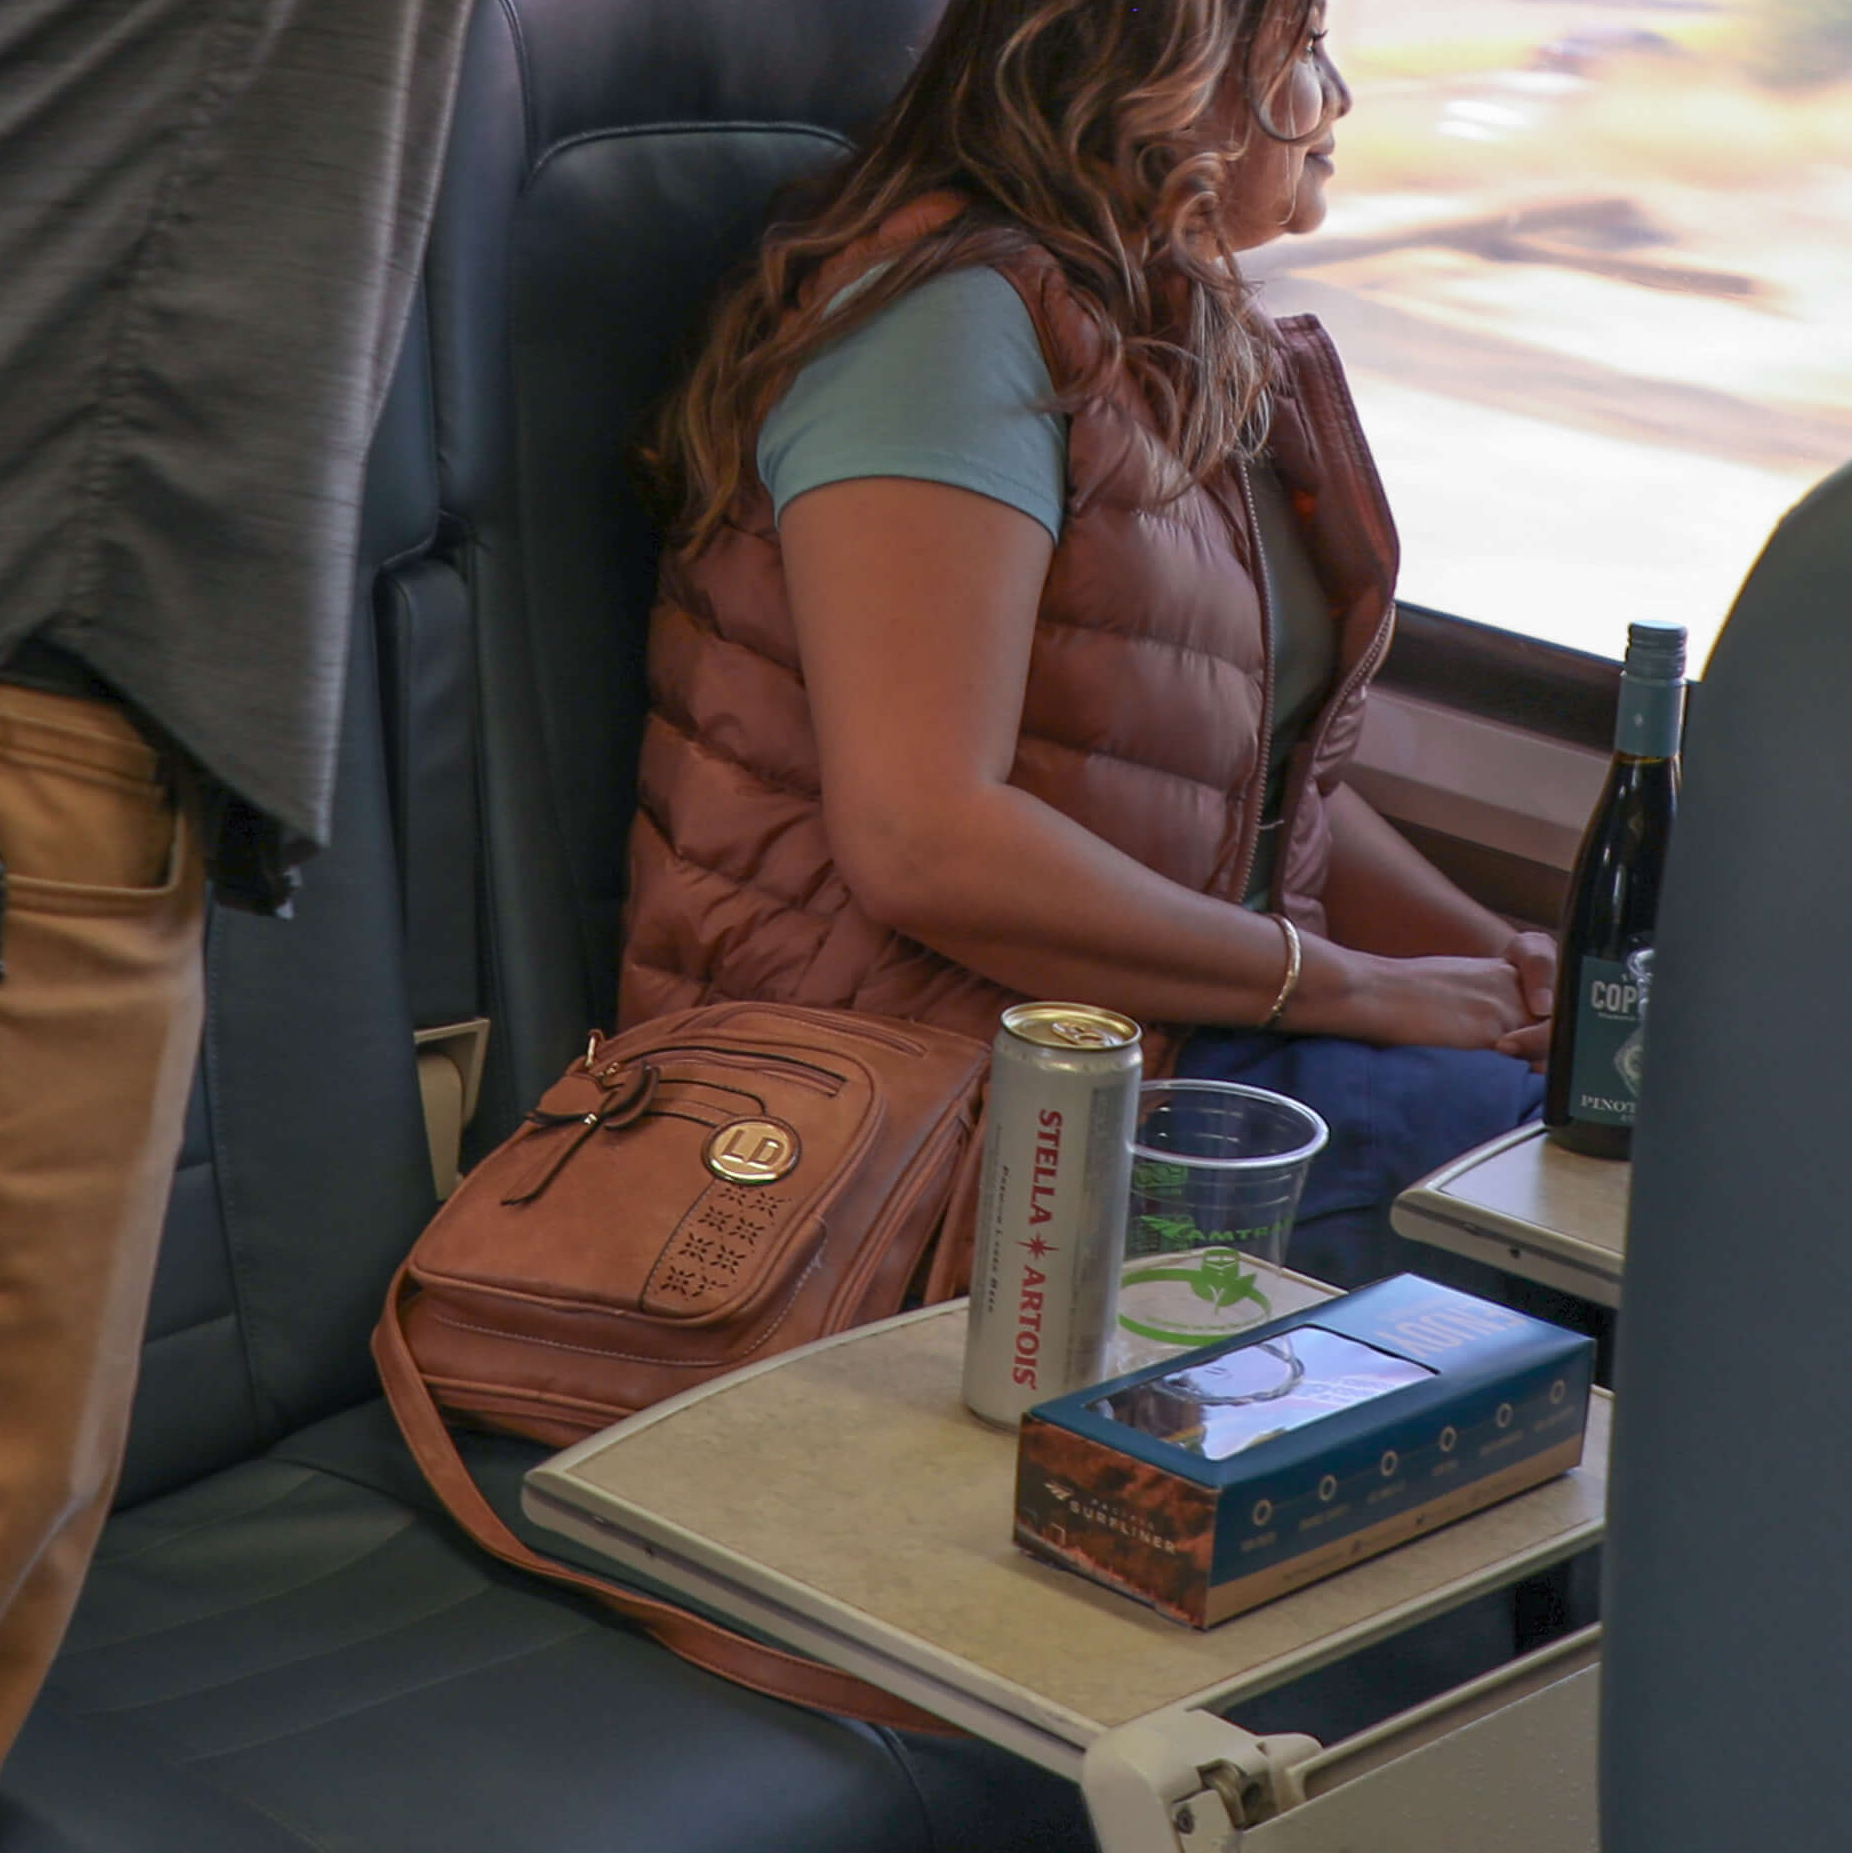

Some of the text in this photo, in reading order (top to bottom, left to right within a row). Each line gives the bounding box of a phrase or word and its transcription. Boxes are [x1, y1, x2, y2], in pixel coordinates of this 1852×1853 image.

[1581, 1094, 1636, 1114] PINOT
[721, 1129, 785, 1168] LD
[1012, 1108, 1063, 1390] STELLA ARTOIS
[1070, 1499, 1176, 1554] SURFLINER
